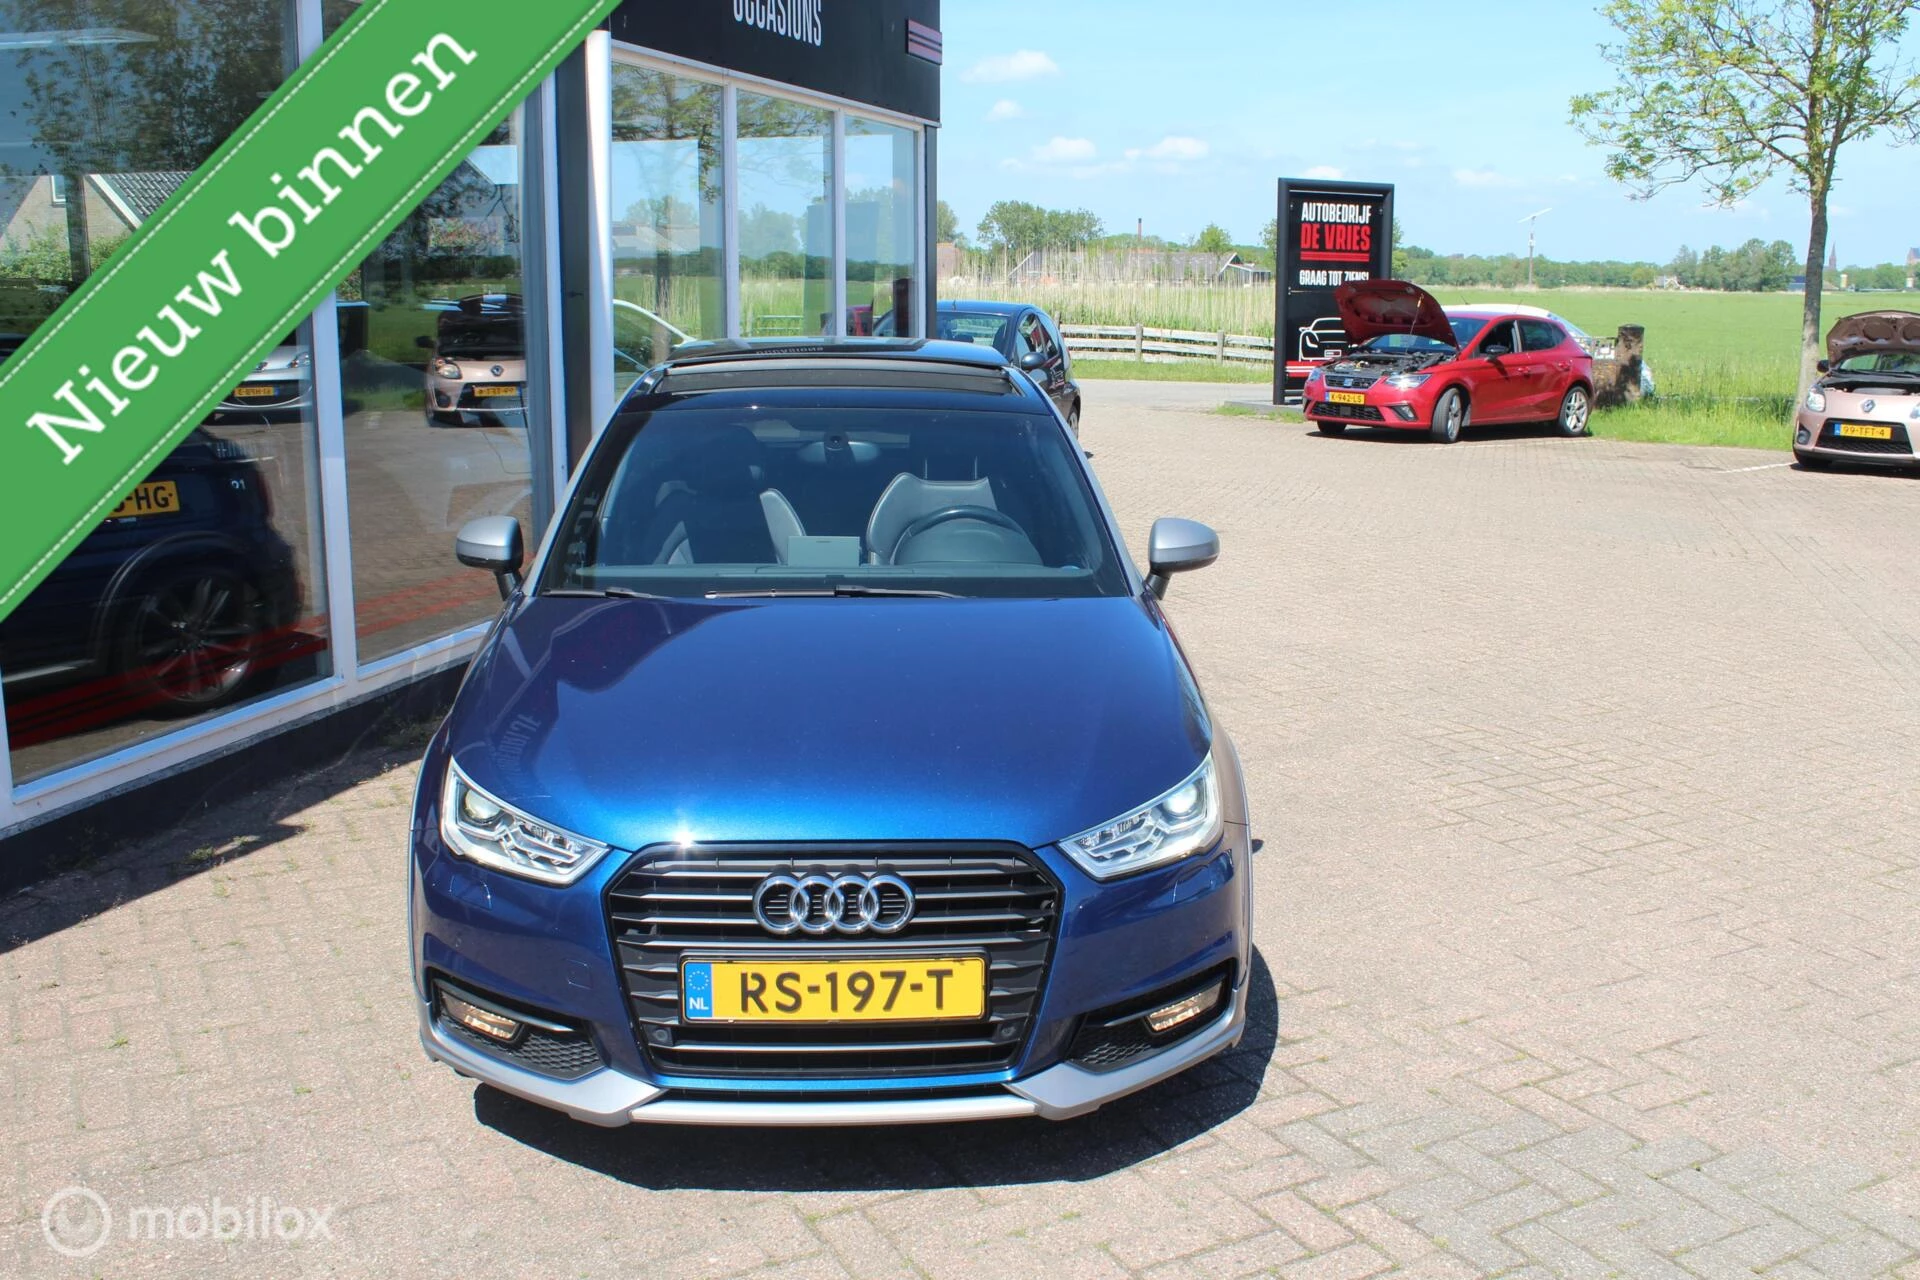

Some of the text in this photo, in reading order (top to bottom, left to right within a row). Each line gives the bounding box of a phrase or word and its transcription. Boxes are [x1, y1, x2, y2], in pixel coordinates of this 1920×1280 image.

[1301, 202, 1372, 224] AUTOBEDRIJF
[1301, 223, 1371, 250] DE VRIES
[1300, 270, 1327, 285] GRAAG
[1328, 271, 1342, 286] TOT
[740, 968, 954, 1014] RS-197-T
[689, 997, 709, 1011] NL
